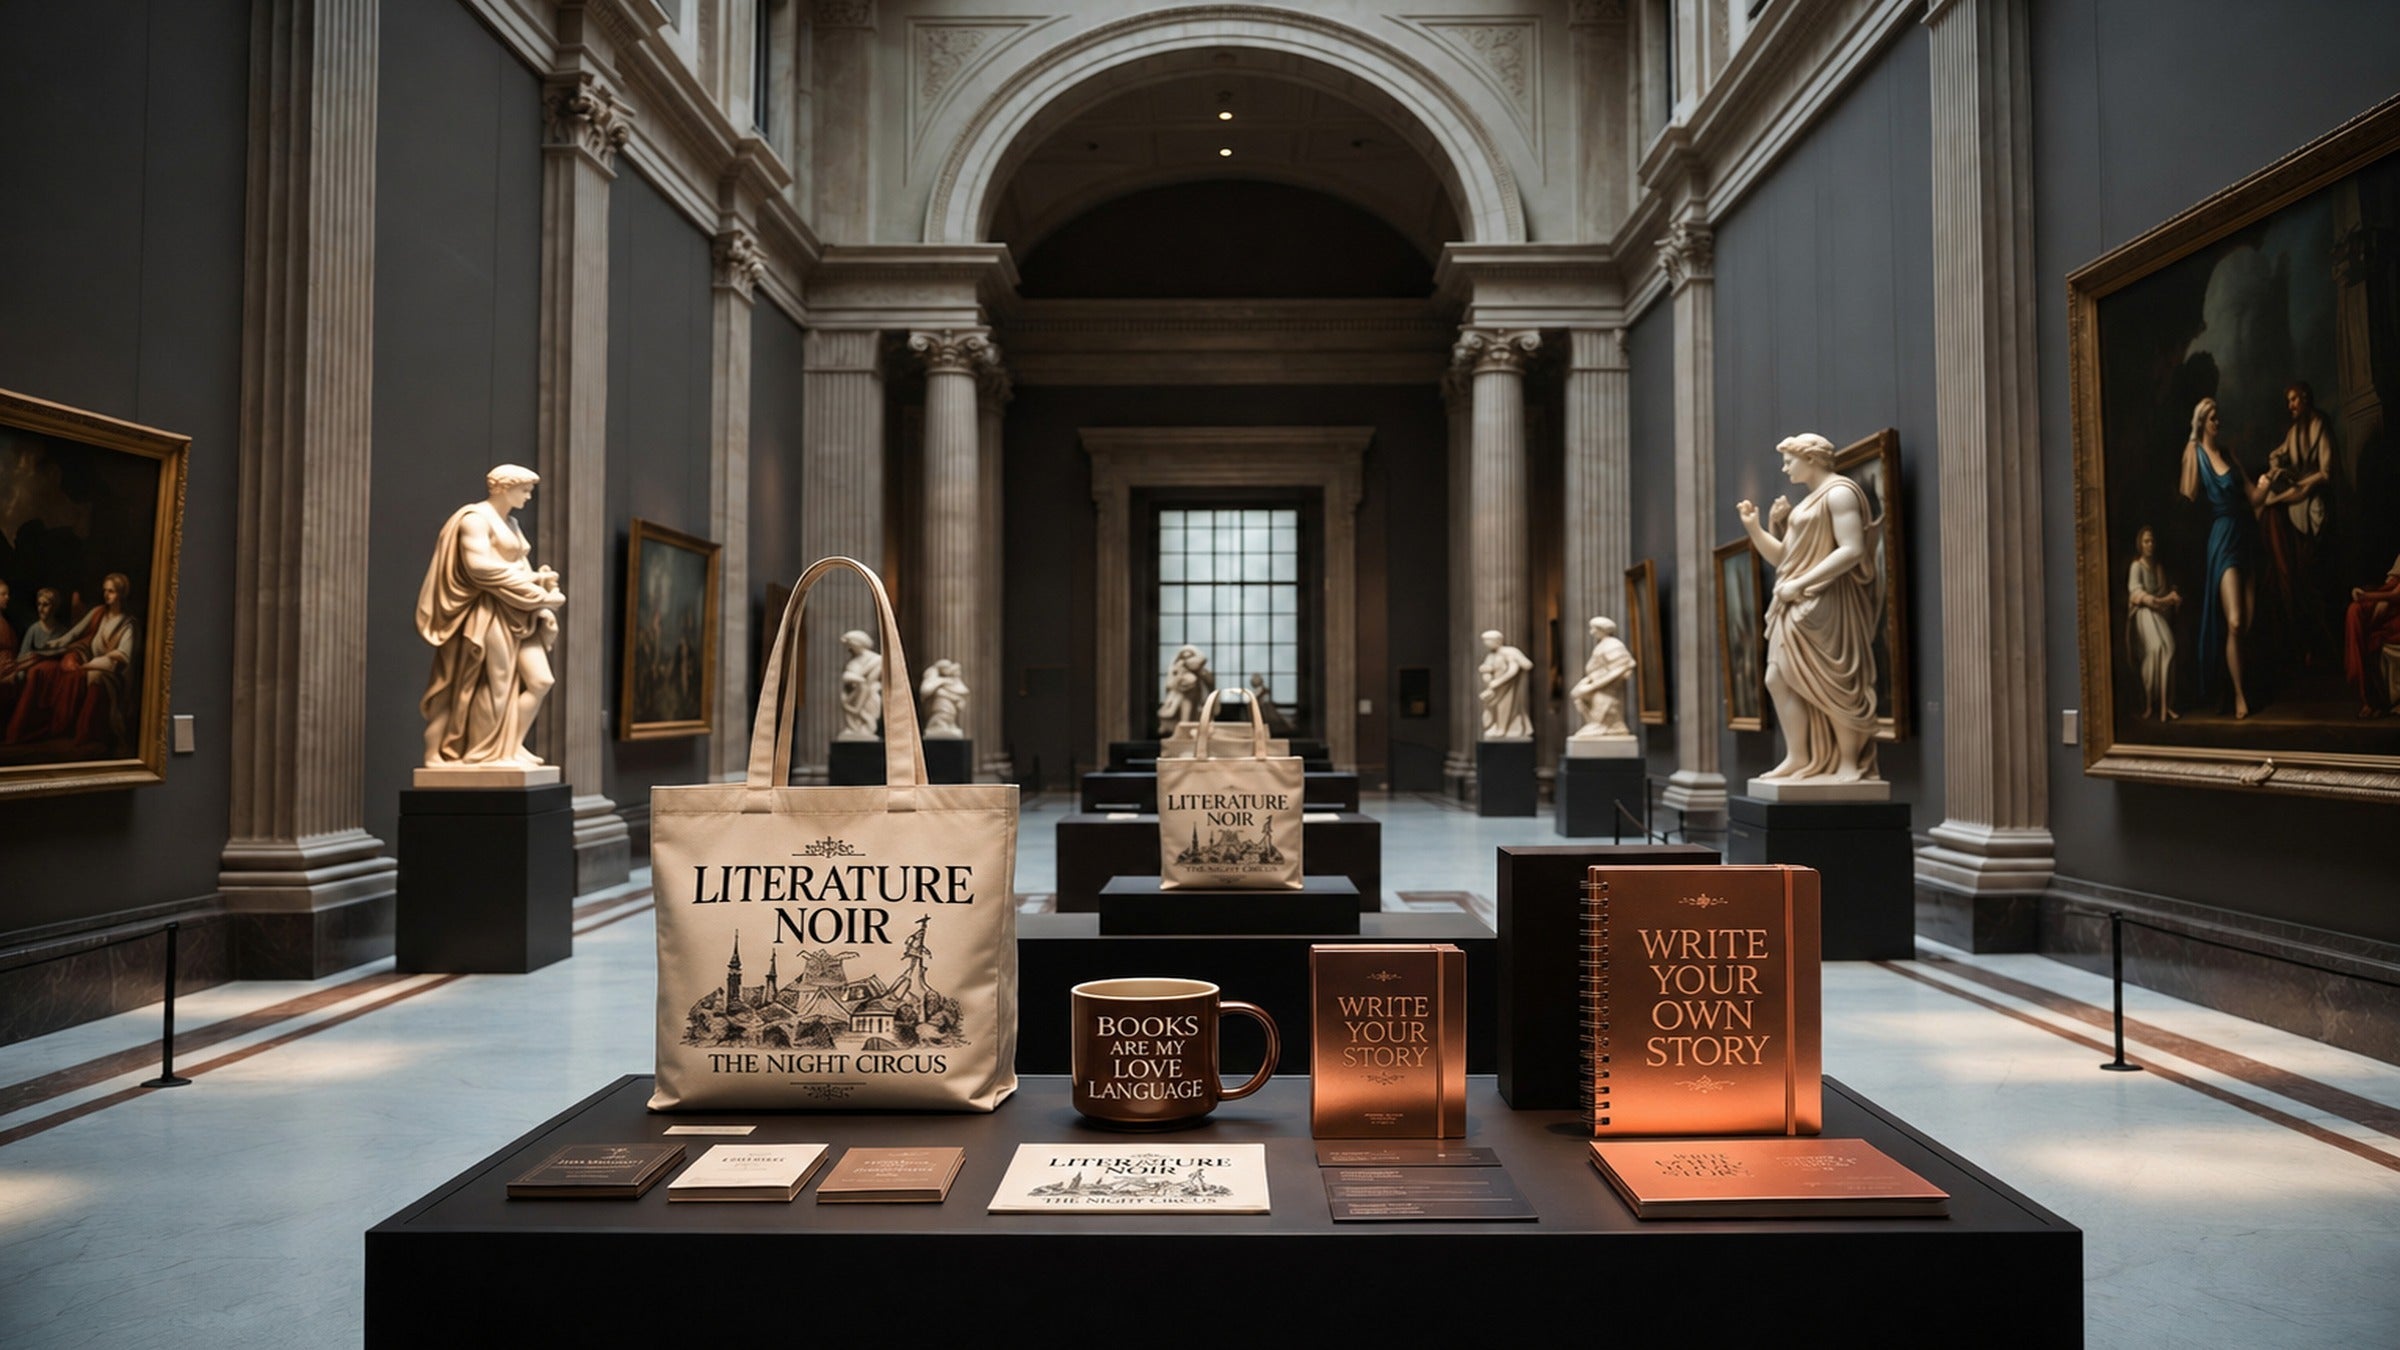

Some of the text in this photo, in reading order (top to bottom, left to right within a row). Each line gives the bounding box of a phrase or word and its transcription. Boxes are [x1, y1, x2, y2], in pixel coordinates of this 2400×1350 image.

[1168, 794, 1289, 811] LITERATURE
[1207, 811, 1254, 826] NOIR
[692, 865, 975, 904] LITERATURE
[773, 907, 893, 944] NOIR
[1638, 929, 1769, 960] WRITE
[1650, 964, 1763, 995] YOUR
[1337, 996, 1429, 1018] WRITE
[1652, 1000, 1754, 1031] OWN
[1097, 1016, 1199, 1037] BOOKS
[1345, 1021, 1428, 1044] YOUR
[1110, 1040, 1185, 1056] ARE MY
[1342, 1046, 1429, 1068] STORY
[1646, 1035, 1770, 1067] STORY
[708, 1053, 947, 1074] THE NIGHT CIRCUS
[1114, 1059, 1183, 1079] LOVE
[1088, 1079, 1203, 1100] LANGUAGE
[1105, 1166, 1176, 1175] NOIR
